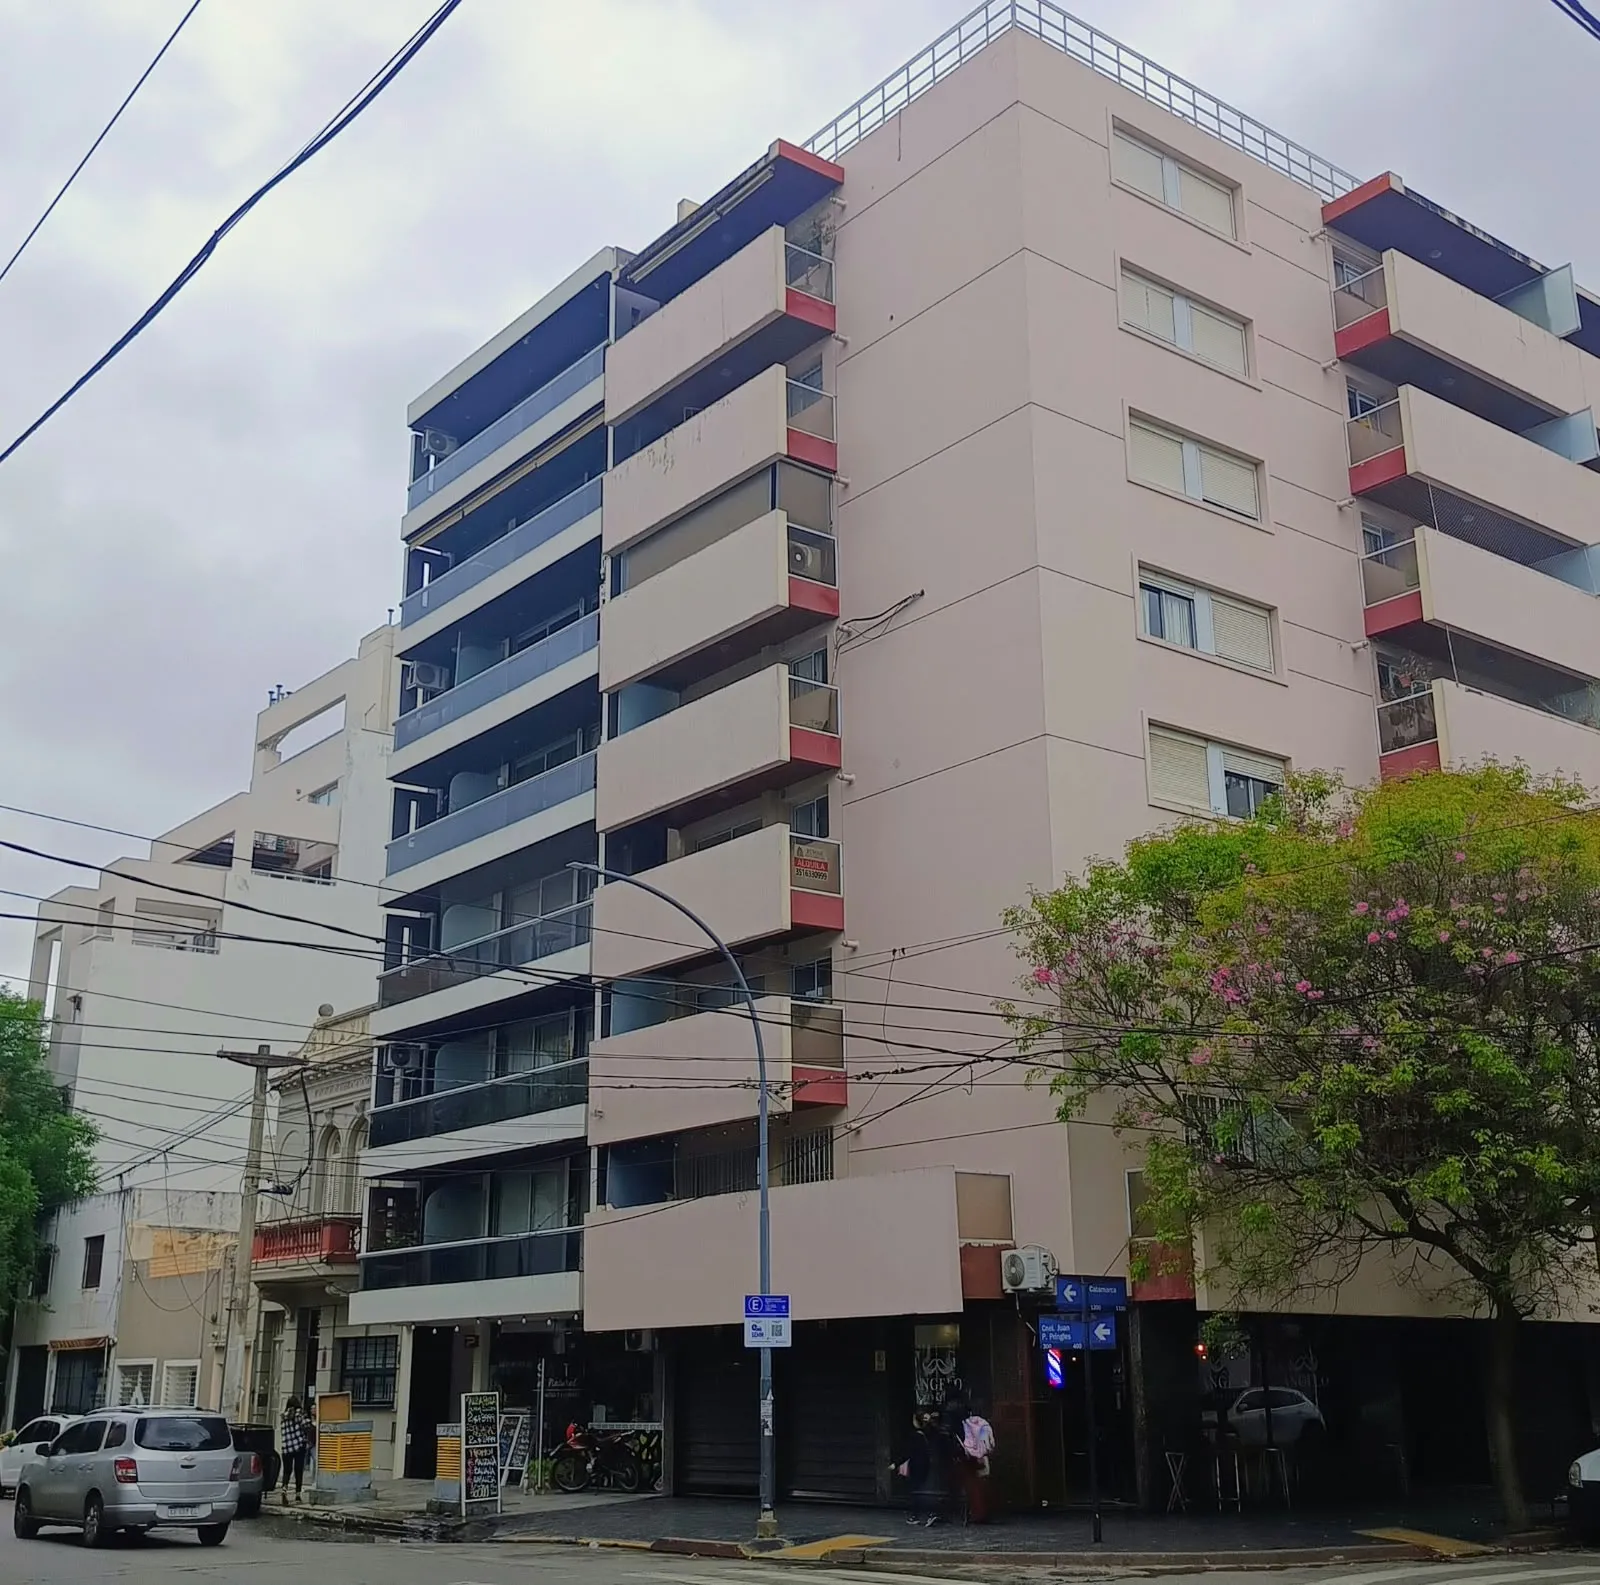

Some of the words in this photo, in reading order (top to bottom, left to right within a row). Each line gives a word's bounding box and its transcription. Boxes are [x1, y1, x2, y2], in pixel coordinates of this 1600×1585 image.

[796, 859, 826, 870] ALQUILA
[1089, 1285, 1117, 1294] Catamarca
[752, 1299, 760, 1310] E
[1049, 1332, 1071, 1341] Pringles
